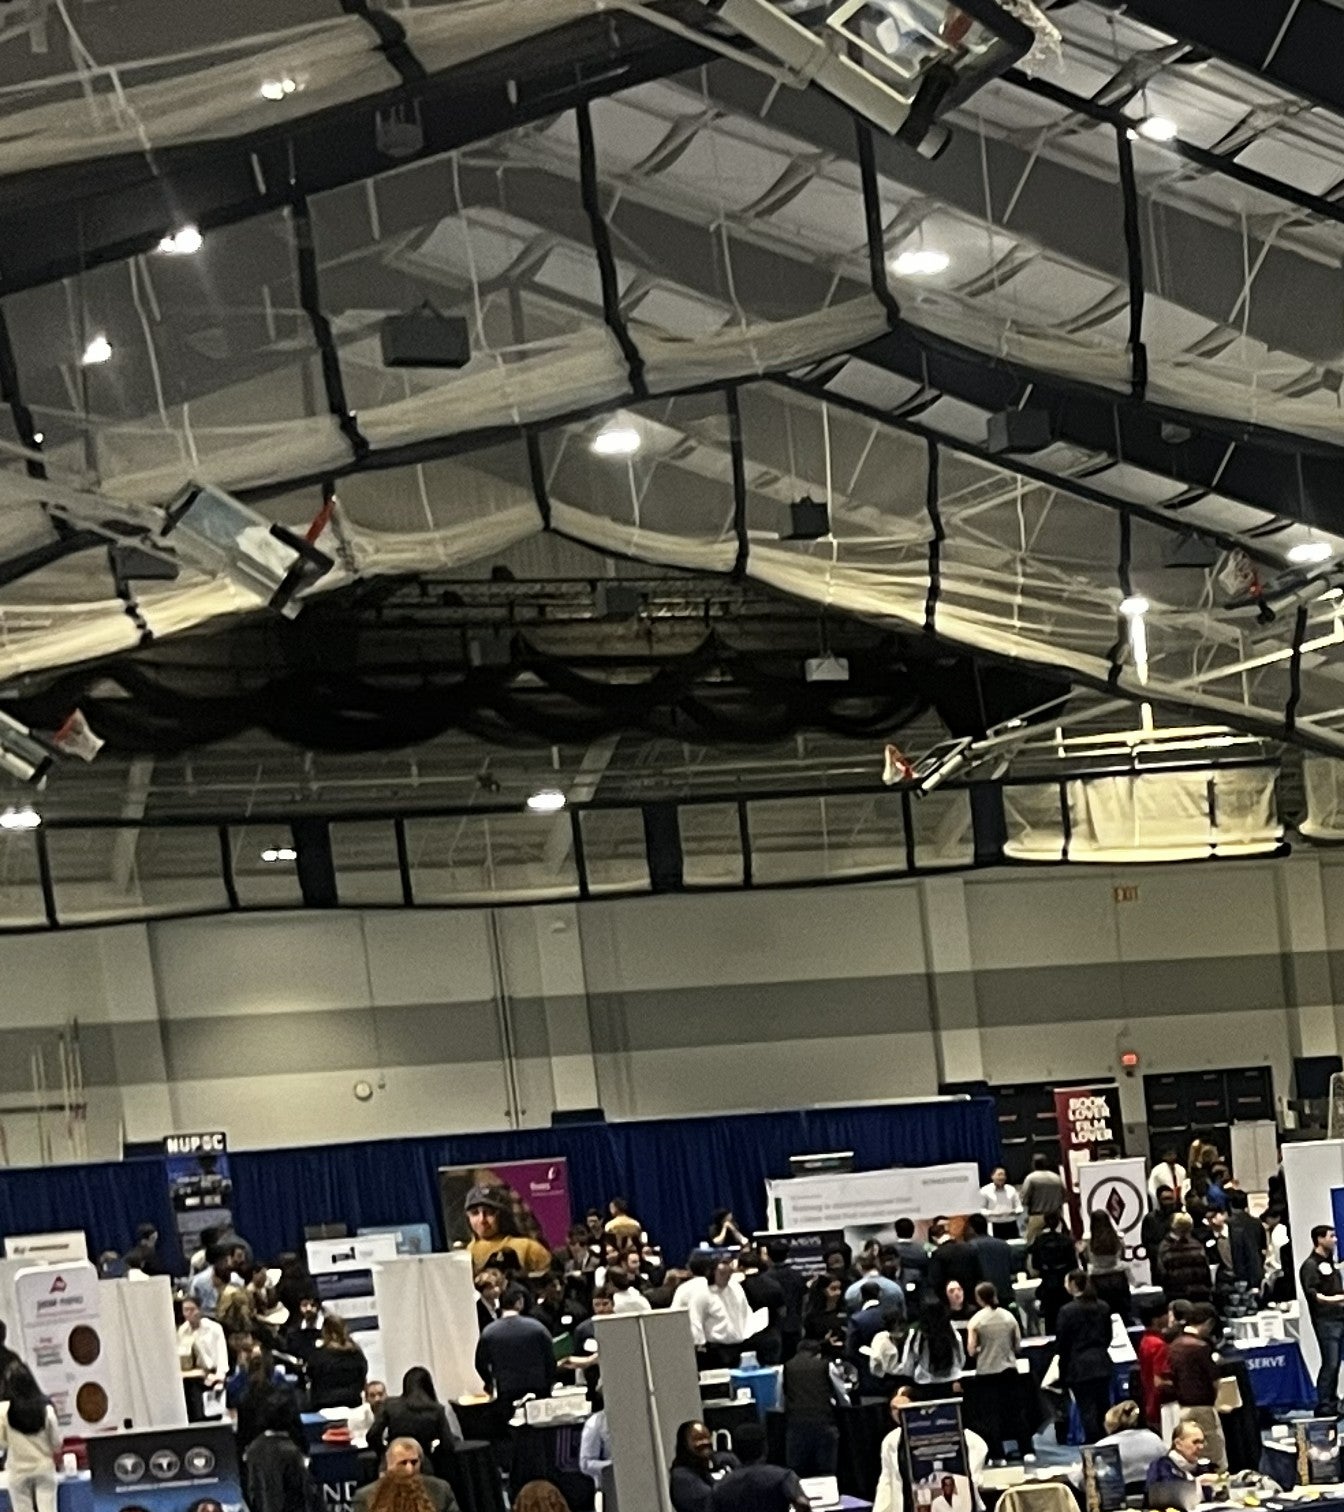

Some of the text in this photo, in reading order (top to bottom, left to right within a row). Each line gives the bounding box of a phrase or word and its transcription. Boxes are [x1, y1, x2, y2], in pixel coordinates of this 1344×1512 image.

[1068, 1095, 1106, 1110] BOOK
[1068, 1104, 1111, 1121] LOVER
[1075, 1119, 1106, 1132] FILM
[1070, 1128, 1114, 1144] LOVER
